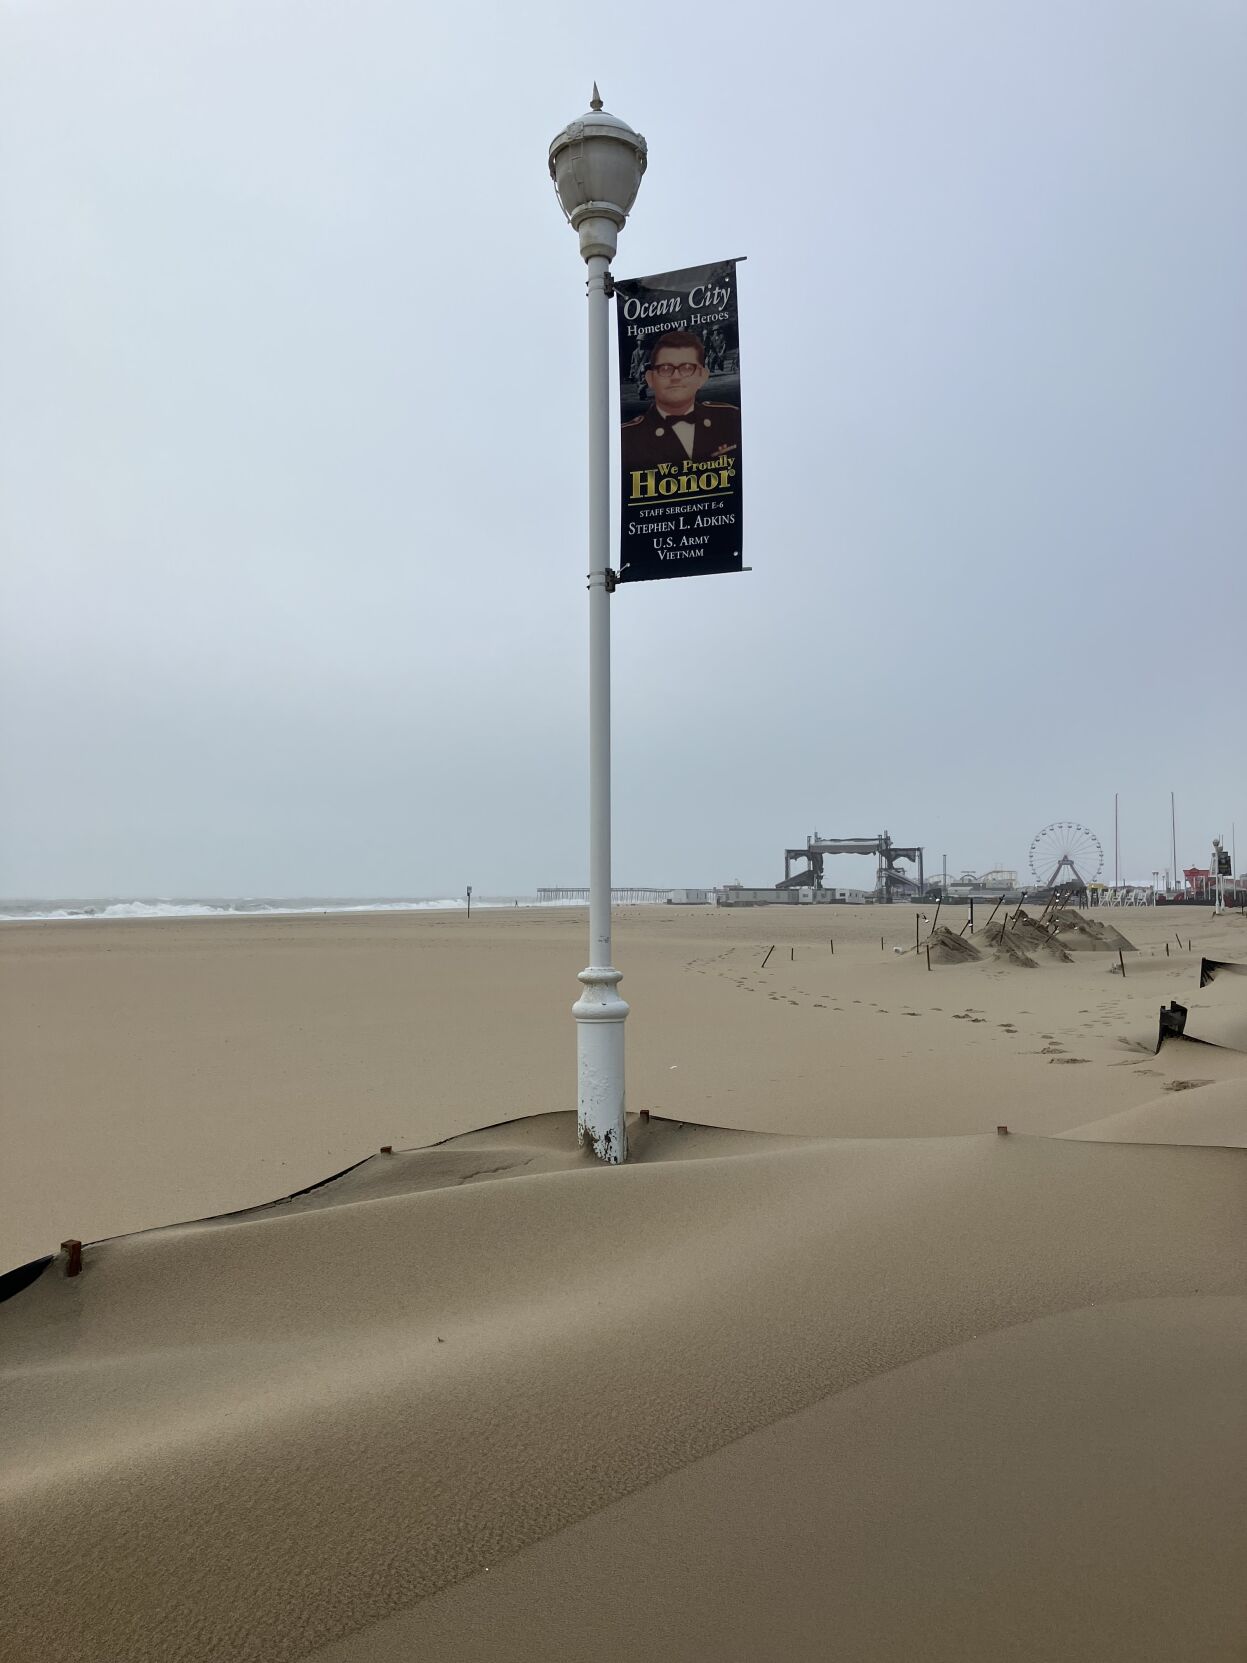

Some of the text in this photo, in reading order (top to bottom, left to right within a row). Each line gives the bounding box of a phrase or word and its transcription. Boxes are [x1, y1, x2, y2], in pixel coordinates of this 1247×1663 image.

[624, 283, 731, 320] Ocean City
[627, 311, 729, 336] Hometown Heroes
[657, 454, 735, 476] We Proudly
[630, 469, 736, 499] Honor
[639, 501, 724, 518] STAFF SERGEANT E-6
[628, 514, 735, 535] STEPHEN L. ADKINS
[653, 535, 710, 549] U.S. ARMY
[657, 549, 704, 560] VIETNAM
